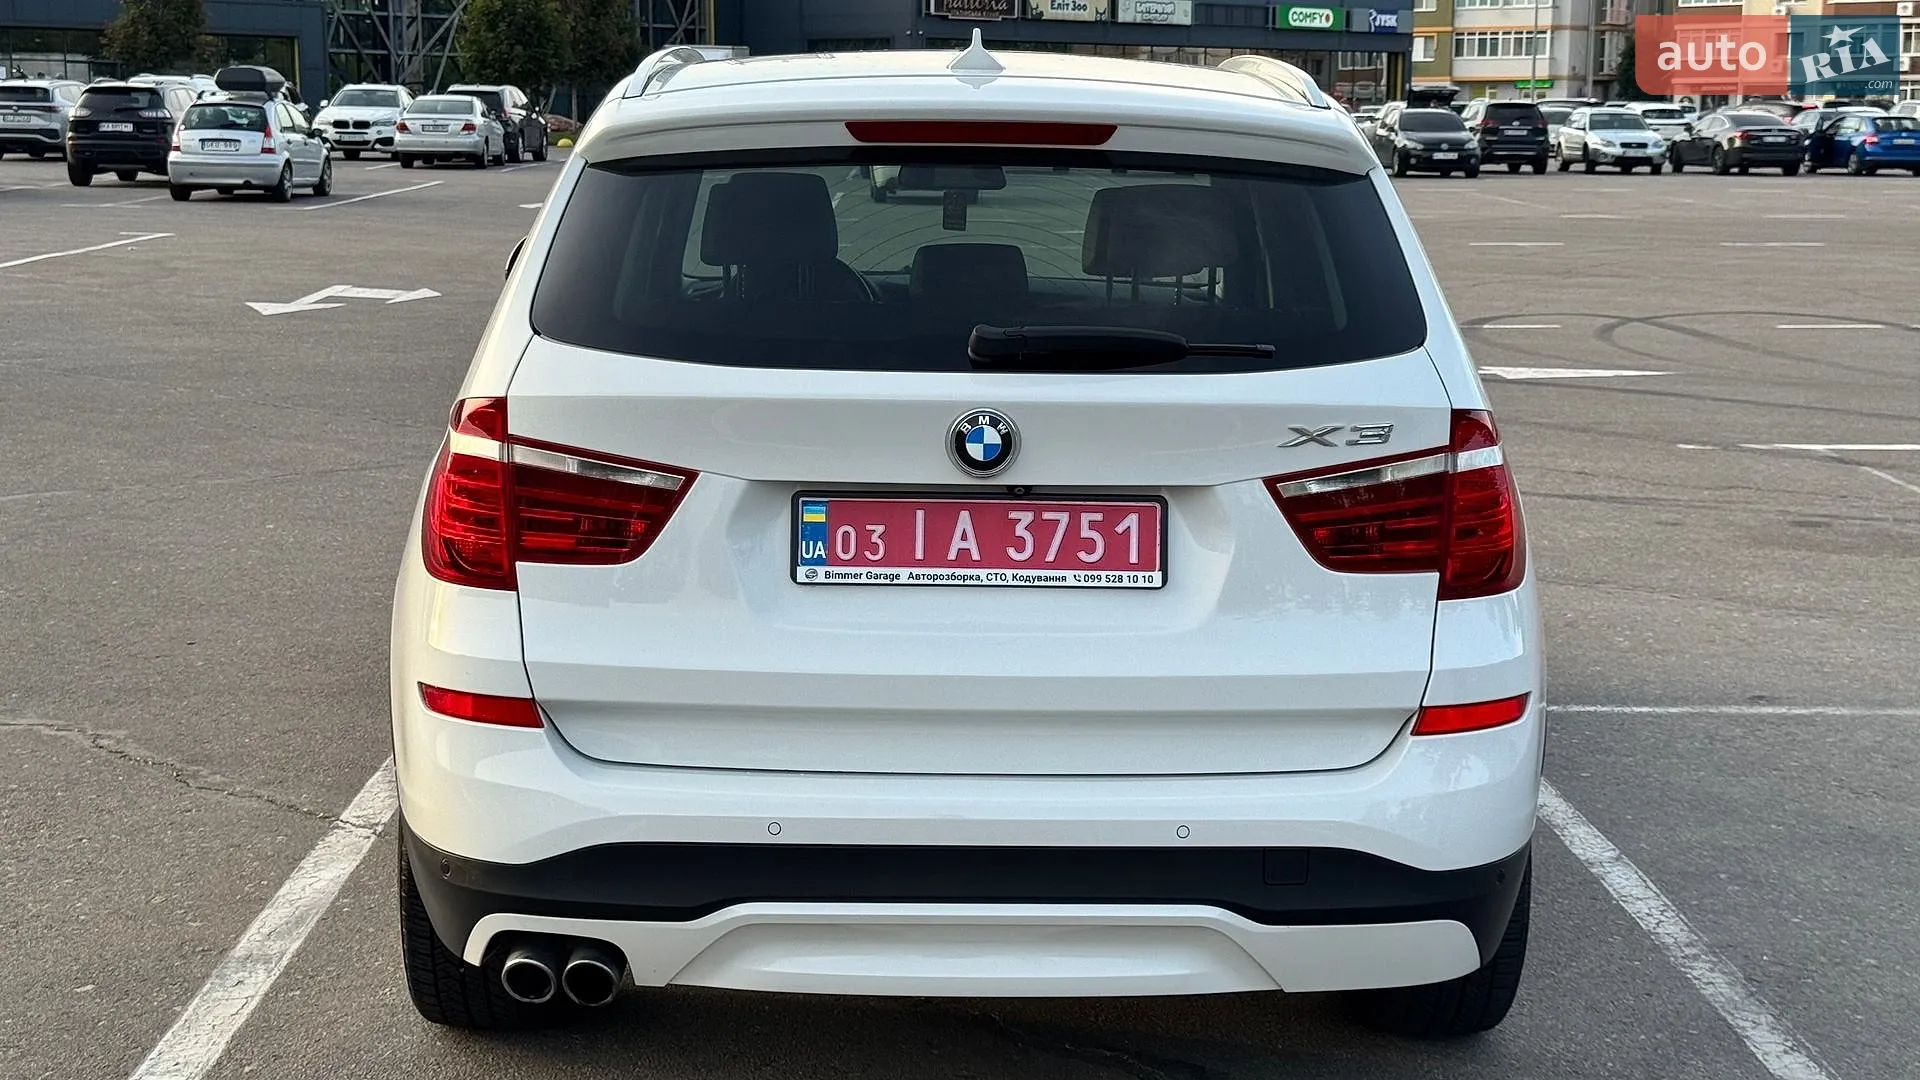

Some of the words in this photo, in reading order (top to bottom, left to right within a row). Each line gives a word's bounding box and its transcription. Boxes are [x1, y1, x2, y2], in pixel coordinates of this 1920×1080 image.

[1291, 11, 1323, 24] COMFY
[1375, 14, 1398, 27] JYSK
[960, 416, 1008, 435] BMW
[1277, 423, 1395, 447] X3
[835, 525, 887, 562] 03
[1005, 511, 1140, 564] 3751
[802, 541, 826, 559] UA
[824, 571, 863, 580] Bimmer
[866, 571, 901, 582] Garage
[907, 571, 983, 583] Авторозборка,
[986, 573, 1009, 584] СТО,
[1012, 573, 1067, 584] Кодування
[1083, 574, 1102, 583] 099
[1105, 575, 1124, 584] 528
[1127, 575, 1138, 584] 10
[1142, 575, 1154, 584] 10
